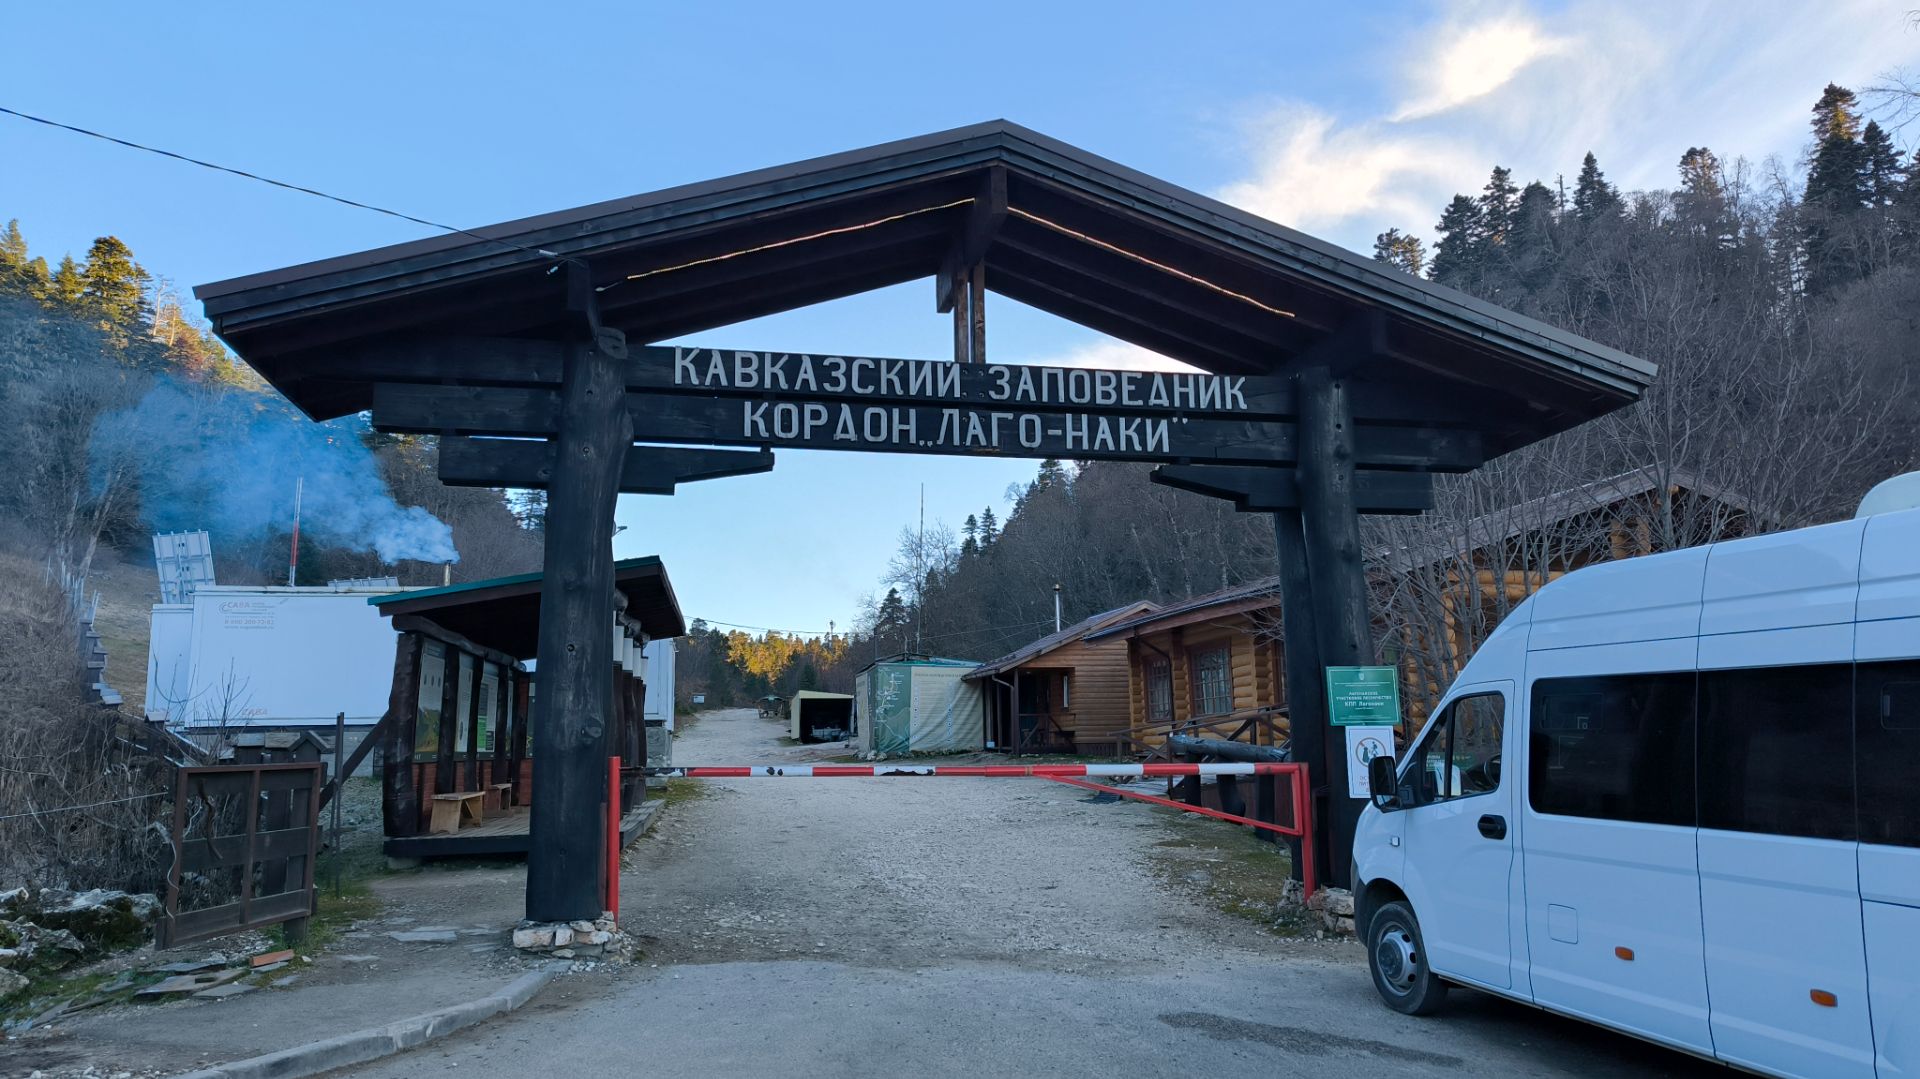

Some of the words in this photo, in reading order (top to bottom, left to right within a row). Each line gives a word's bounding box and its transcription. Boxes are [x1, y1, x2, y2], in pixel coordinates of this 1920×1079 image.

[674, 346, 961, 398] КАВКАЗСКИЙ
[988, 365, 1248, 410] ЗАПОВЕДНИК
[743, 401, 917, 444] КОРДОН
